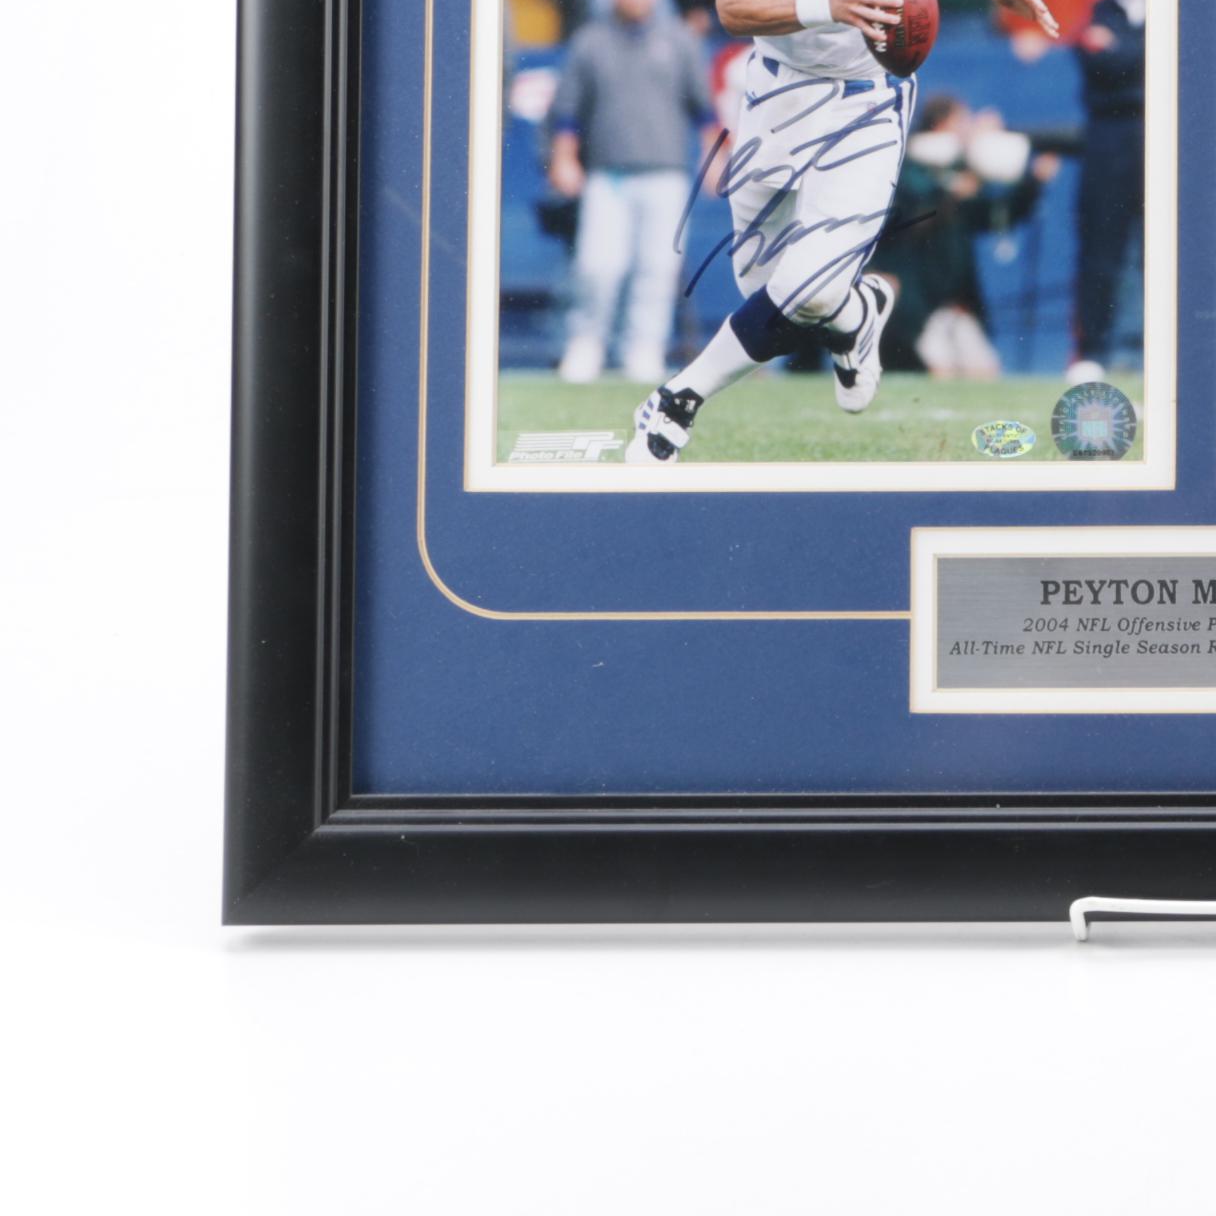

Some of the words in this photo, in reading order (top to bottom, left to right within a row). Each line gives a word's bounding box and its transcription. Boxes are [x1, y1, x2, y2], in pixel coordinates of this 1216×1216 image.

[1040, 579, 1179, 605] PEYTON
[1022, 617, 1070, 633] 2004
[1076, 617, 1112, 633] NFL
[1117, 616, 1201, 636] Offensive
[949, 640, 1026, 655] All-Time
[1031, 639, 1067, 655] NFL
[1072, 639, 1130, 659] Single
[1136, 639, 1201, 655] Season
